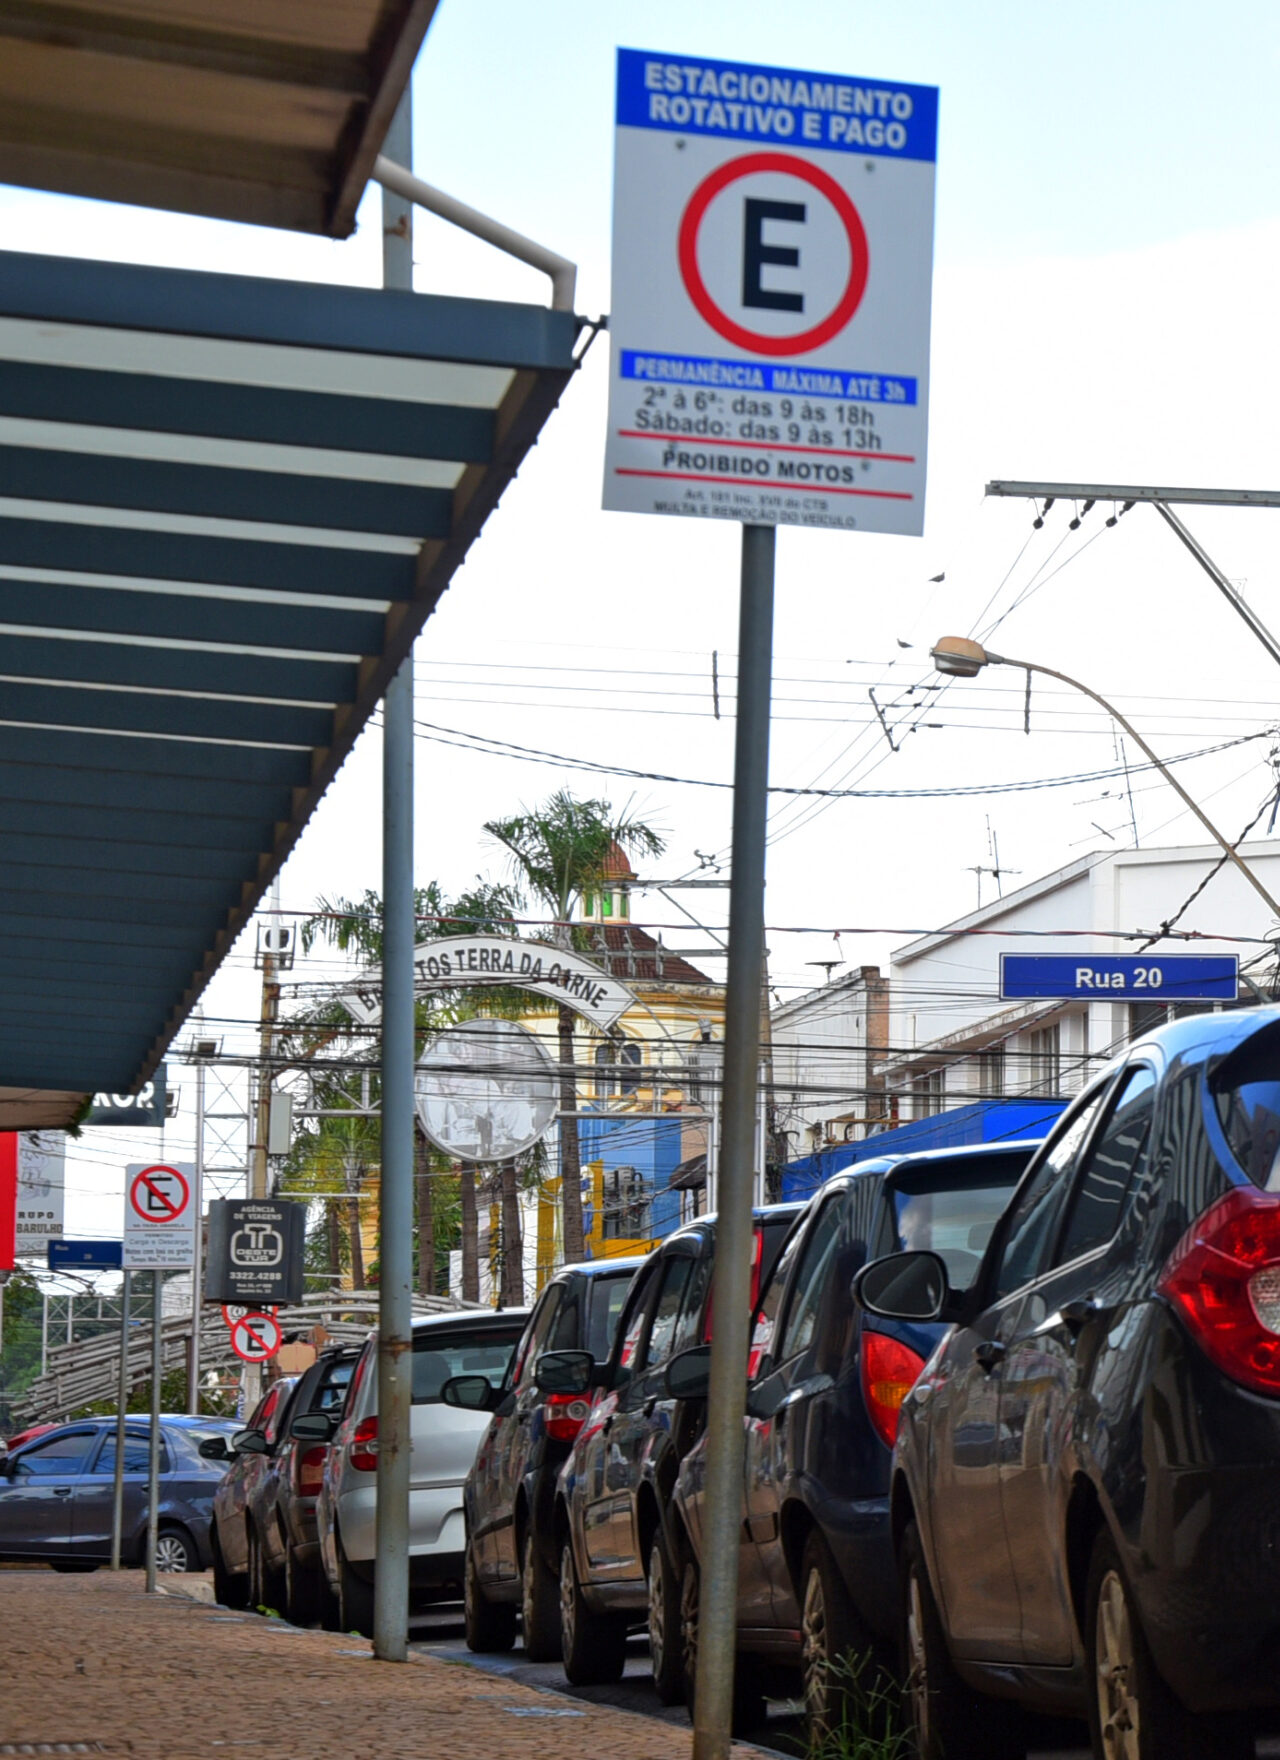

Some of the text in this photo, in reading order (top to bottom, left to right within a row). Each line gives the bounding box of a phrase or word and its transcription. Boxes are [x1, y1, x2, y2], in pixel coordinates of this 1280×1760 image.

[644, 61, 913, 120] ESTACIONAMENTO
[649, 93, 907, 150] ROTATIVO E PAGO
[742, 196, 807, 314] E
[634, 356, 906, 401] PERMANÊNCIA MÁXIMA ATÉ 3h
[673, 389, 688, 409] à
[732, 395, 773, 417] das
[780, 399, 794, 421] 9
[799, 402, 827, 422] às
[836, 405, 874, 426] 18h
[635, 408, 882, 450] Sábado: das 9 às 13h
[662, 449, 855, 483] PROIBIDO MOTOS
[712, 504, 777, 522] REMOÇÃO
[454, 948, 515, 973] TERRA
[520, 952, 542, 977] DA
[548, 962, 609, 1009] CARNE
[1075, 967, 1162, 988] Rua 20
[233, 1212, 283, 1221] DE VIAGENS
[240, 1204, 276, 1213] AGÊNCIA
[16, 1223, 64, 1234] BARULHO
[236, 1248, 277, 1256] OESTE
